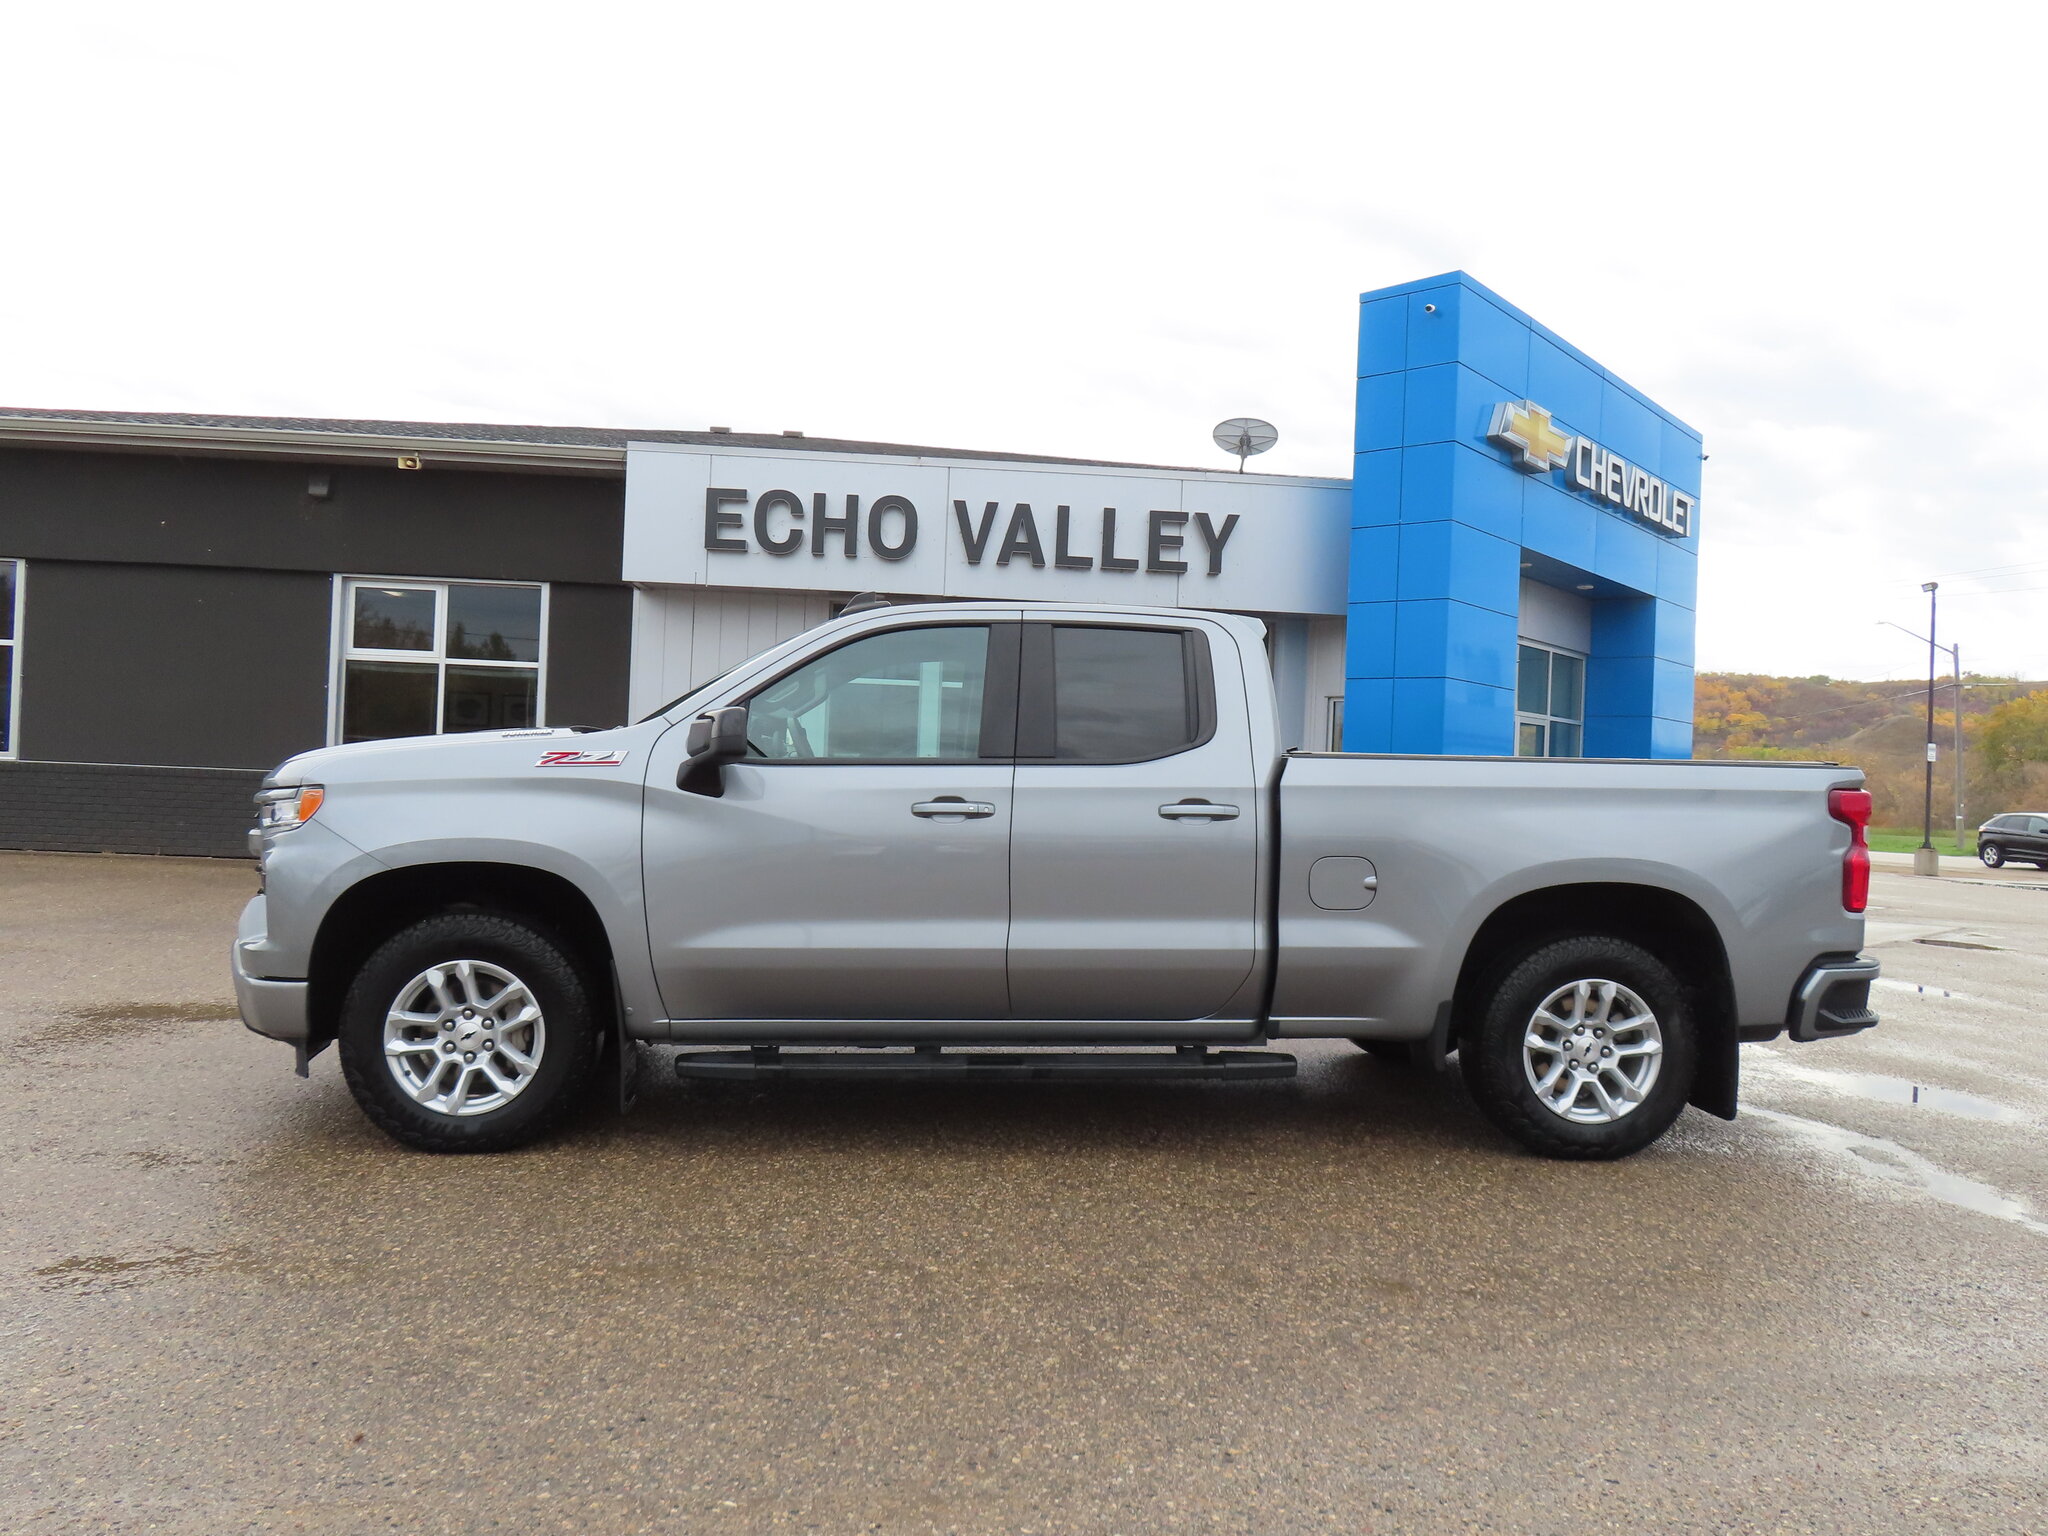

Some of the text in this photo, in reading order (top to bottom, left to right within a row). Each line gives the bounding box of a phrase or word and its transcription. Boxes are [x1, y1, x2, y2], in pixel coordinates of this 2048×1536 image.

[1575, 436, 1695, 537] CHEVROLET
[704, 488, 1240, 575] ECHO VALLEY
[535, 751, 629, 767] Z71
